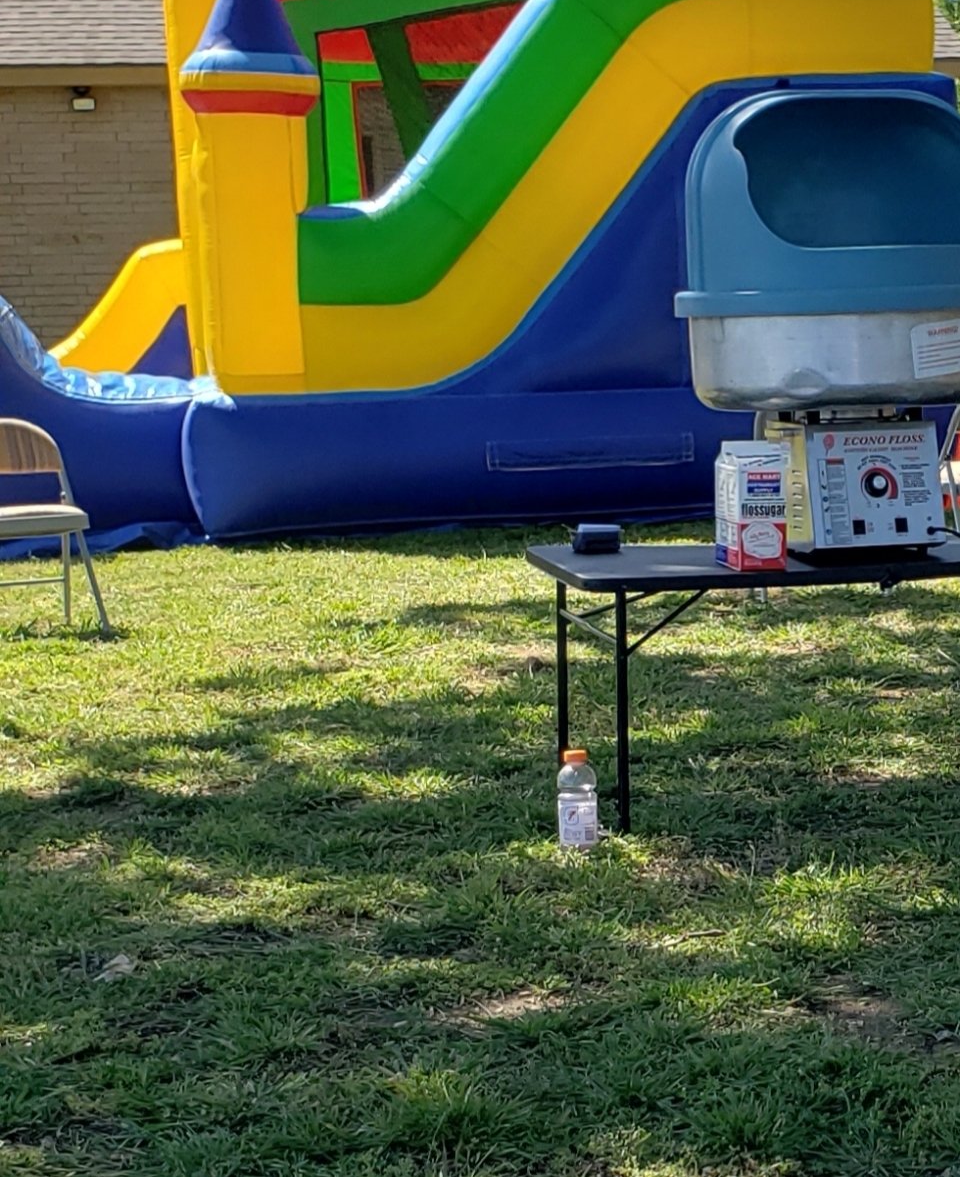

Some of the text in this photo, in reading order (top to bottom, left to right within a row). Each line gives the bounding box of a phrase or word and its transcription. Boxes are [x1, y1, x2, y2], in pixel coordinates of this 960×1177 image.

[843, 434, 925, 446] ECONO FLOSS
[741, 503, 786, 518] flossugar
